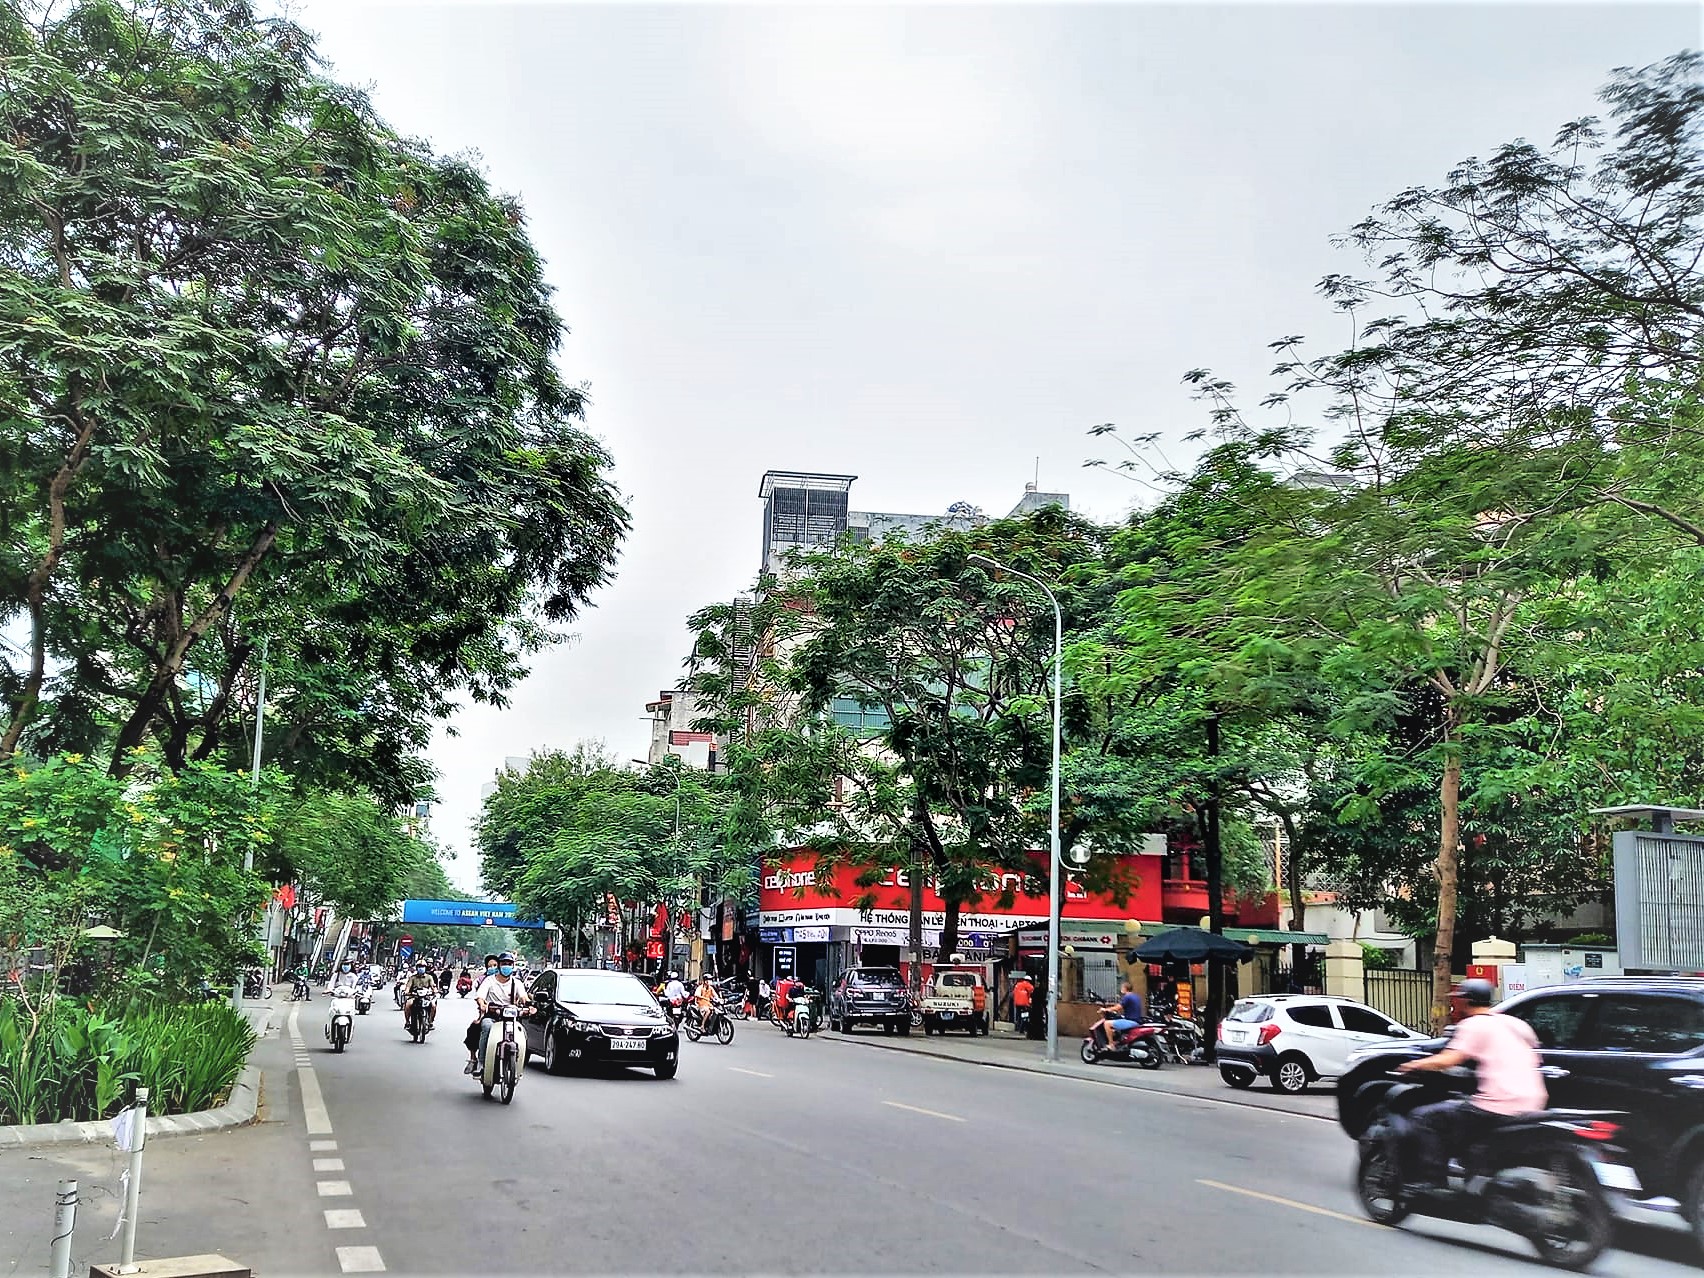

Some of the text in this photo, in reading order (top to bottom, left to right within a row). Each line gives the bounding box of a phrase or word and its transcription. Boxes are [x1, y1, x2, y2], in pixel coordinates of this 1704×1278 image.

[860, 911, 873, 924] HỆ
[875, 911, 909, 924] THỐNG
[968, 918, 998, 930] THOẠI
